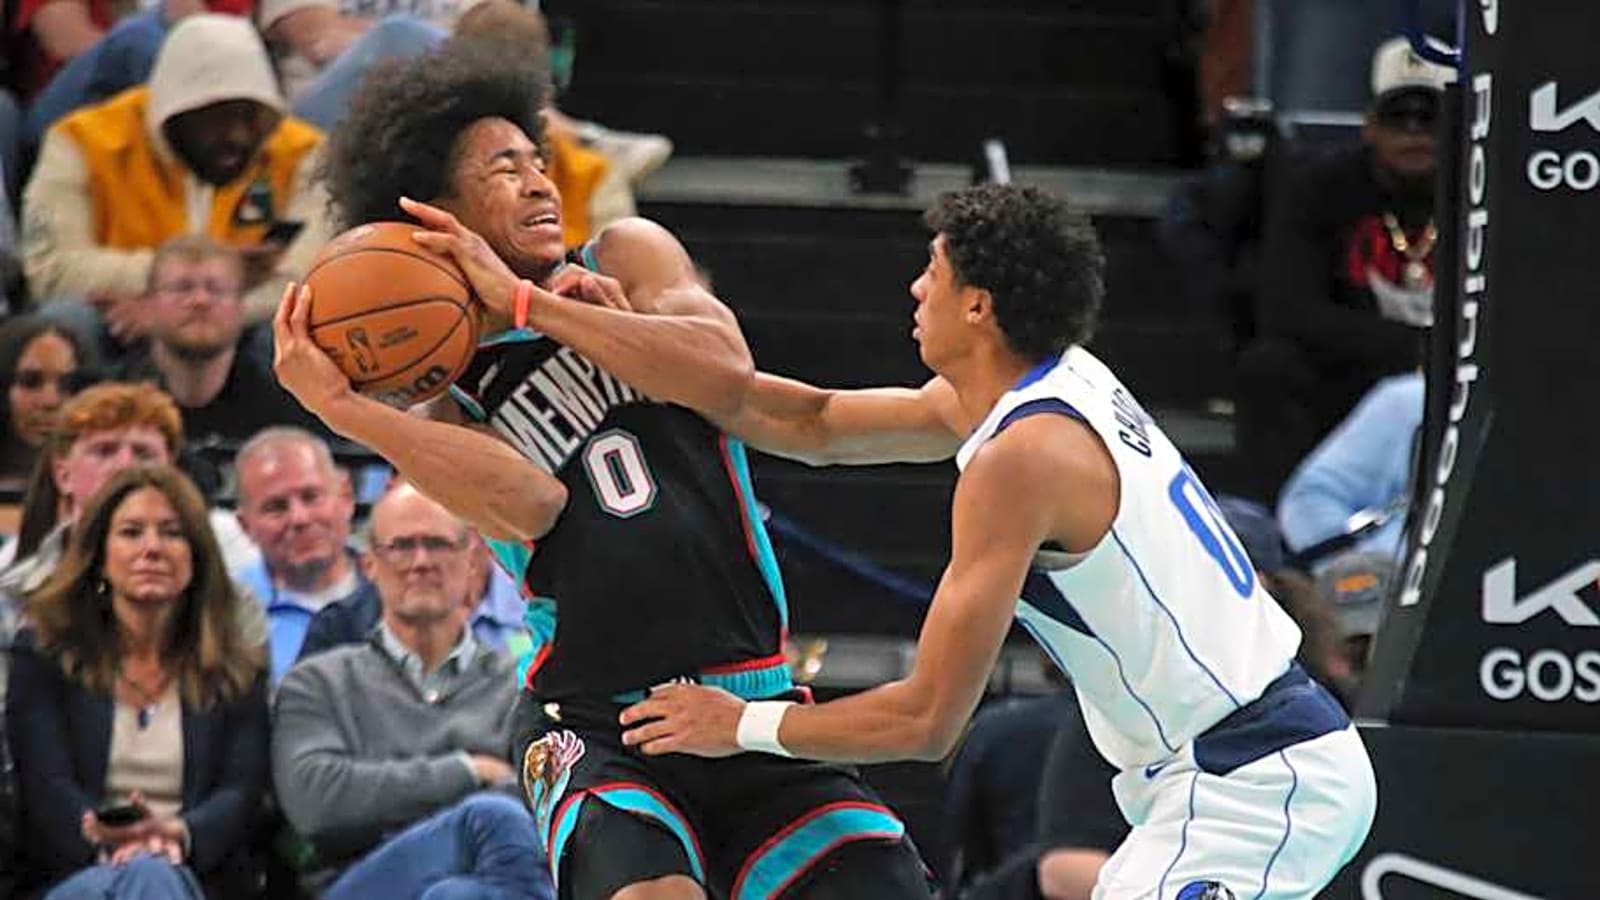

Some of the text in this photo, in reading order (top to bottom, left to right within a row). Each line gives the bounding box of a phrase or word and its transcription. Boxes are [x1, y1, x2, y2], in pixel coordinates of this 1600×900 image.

[1400, 73, 1492, 607] Robinhood
[491, 346, 657, 476] MEMP
[582, 427, 657, 518] 0
